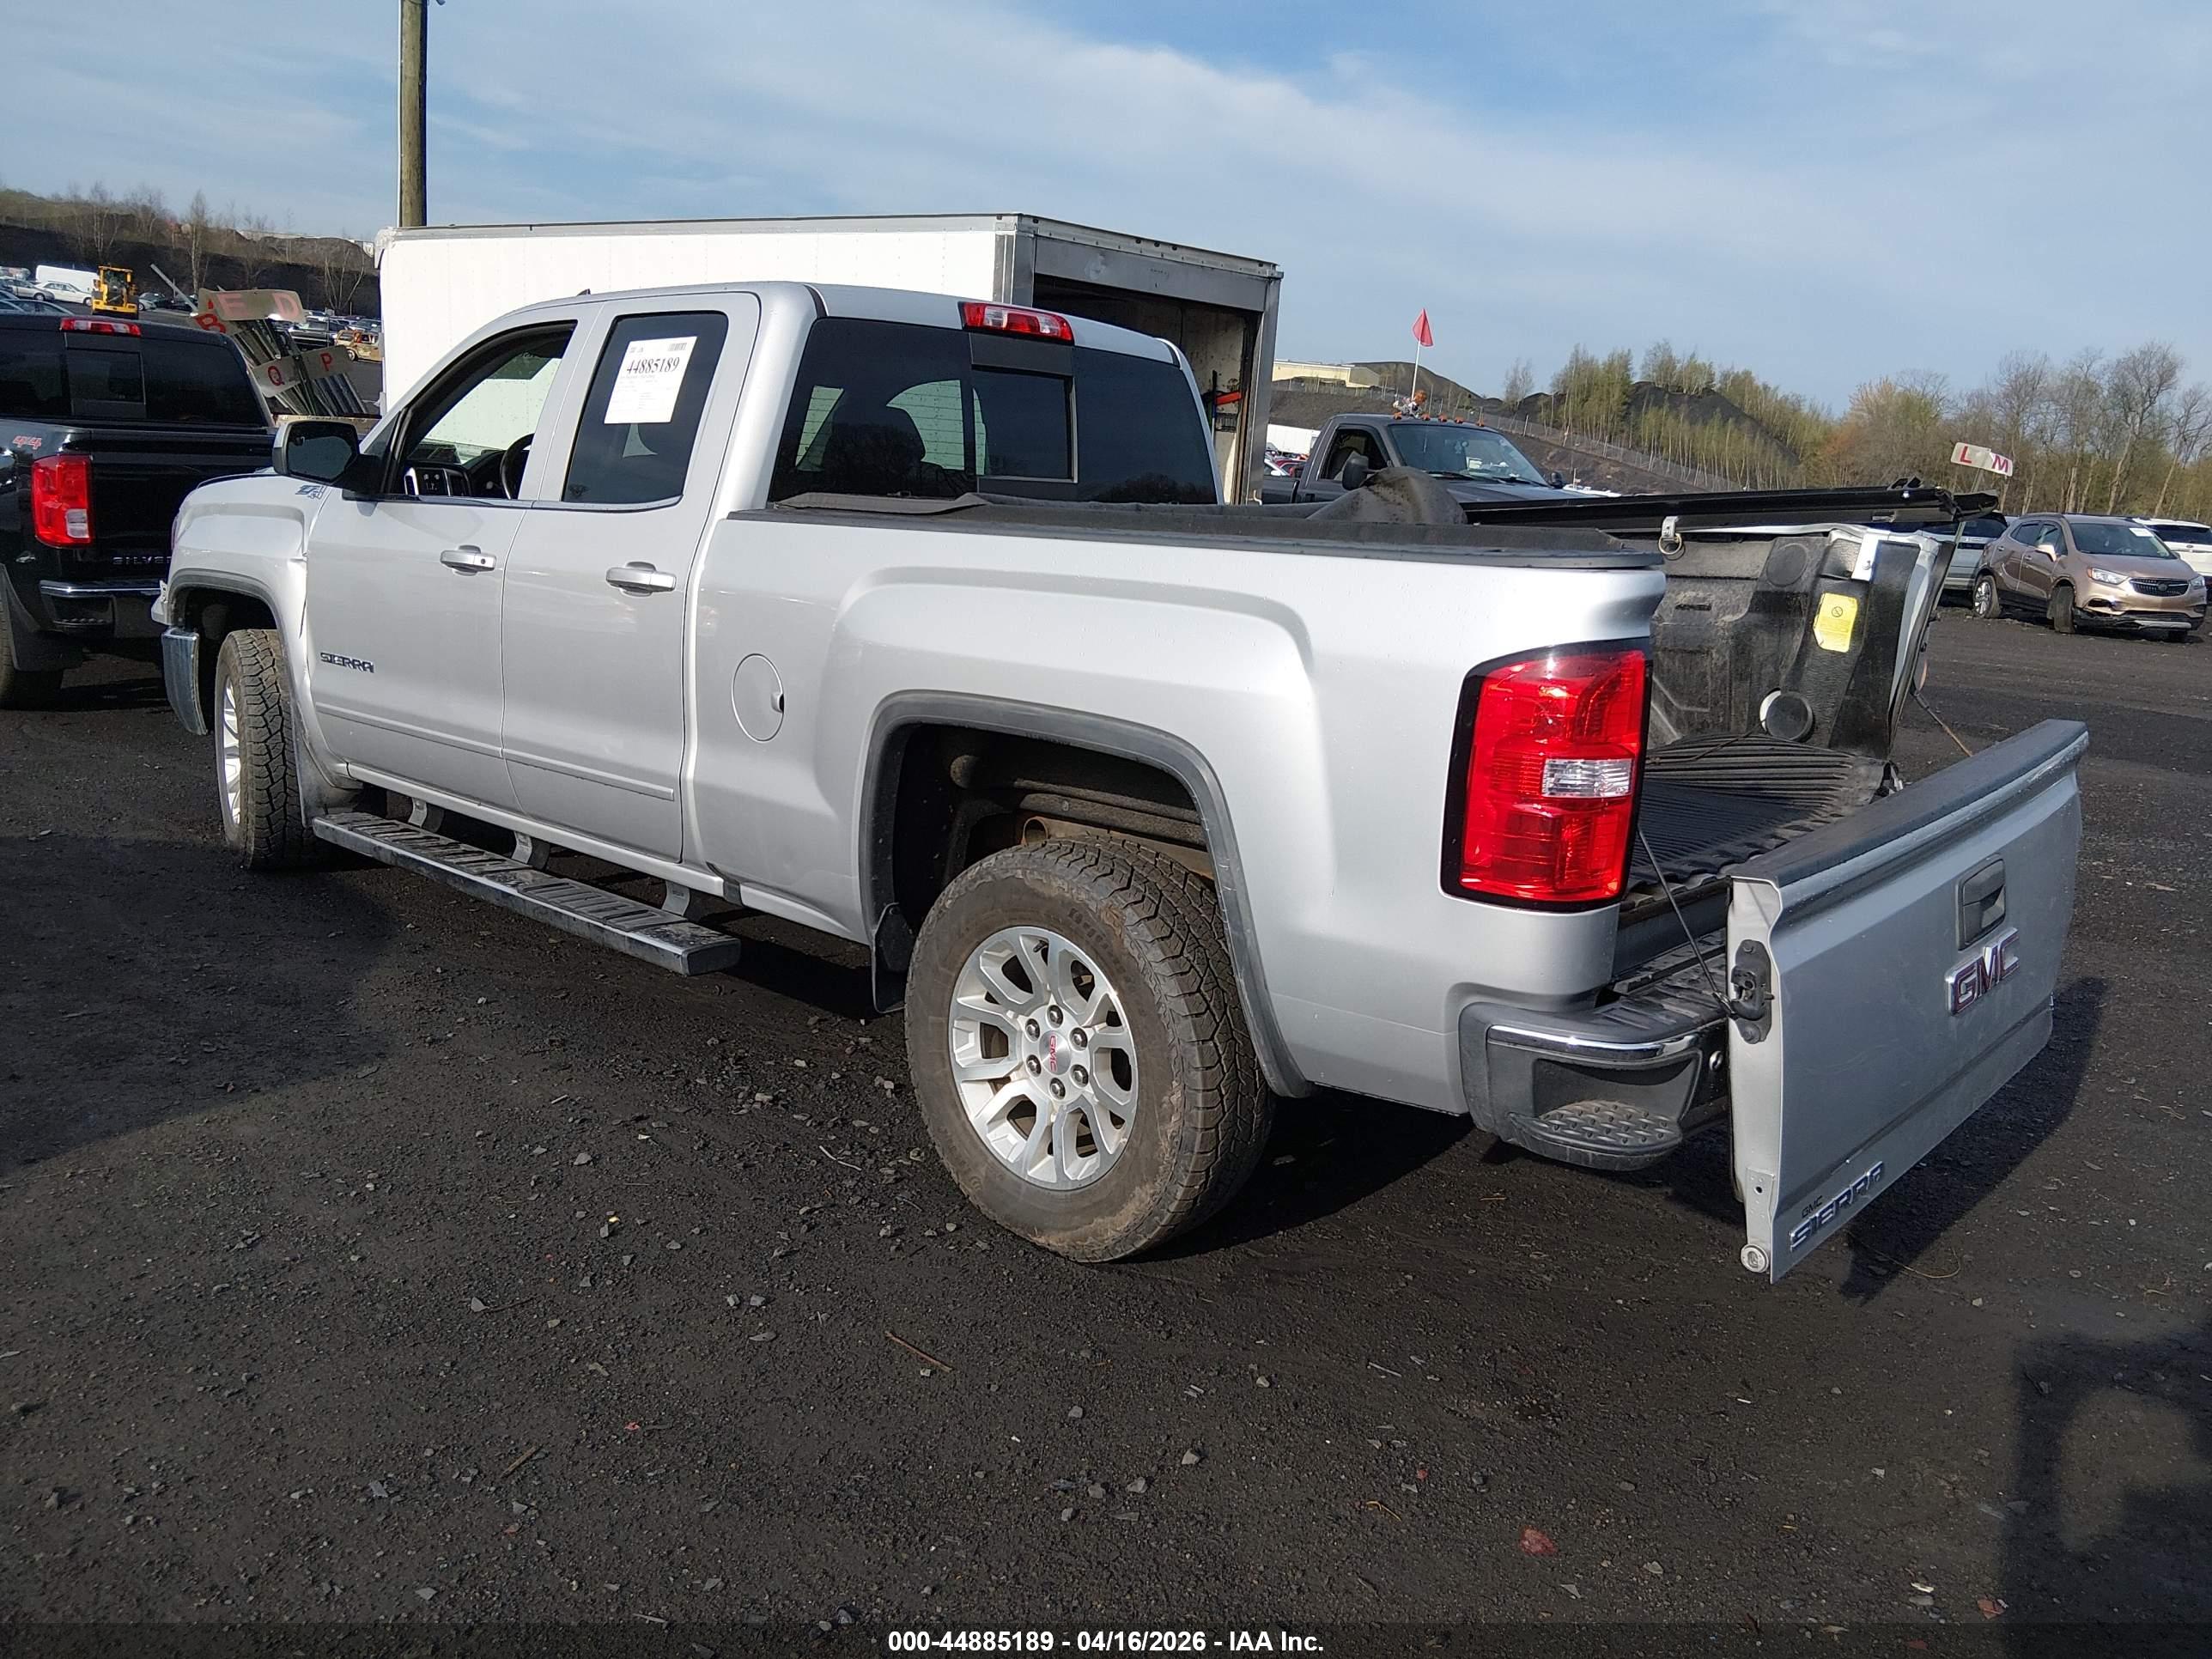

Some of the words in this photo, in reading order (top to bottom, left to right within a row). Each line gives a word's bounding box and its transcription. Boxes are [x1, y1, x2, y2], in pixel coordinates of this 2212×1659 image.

[216, 293, 246, 319] E
[272, 293, 301, 319] D
[319, 353, 332, 371] P
[626, 357, 680, 374] 44885189
[268, 366, 284, 386] Q
[1960, 446, 1972, 464] L
[1992, 454, 2009, 473] M
[320, 652, 374, 674] SIERRA
[1945, 927, 2020, 1016] GMC
[1790, 1160, 1884, 1252] SIERRA
[1802, 1195, 1823, 1218] GMC
